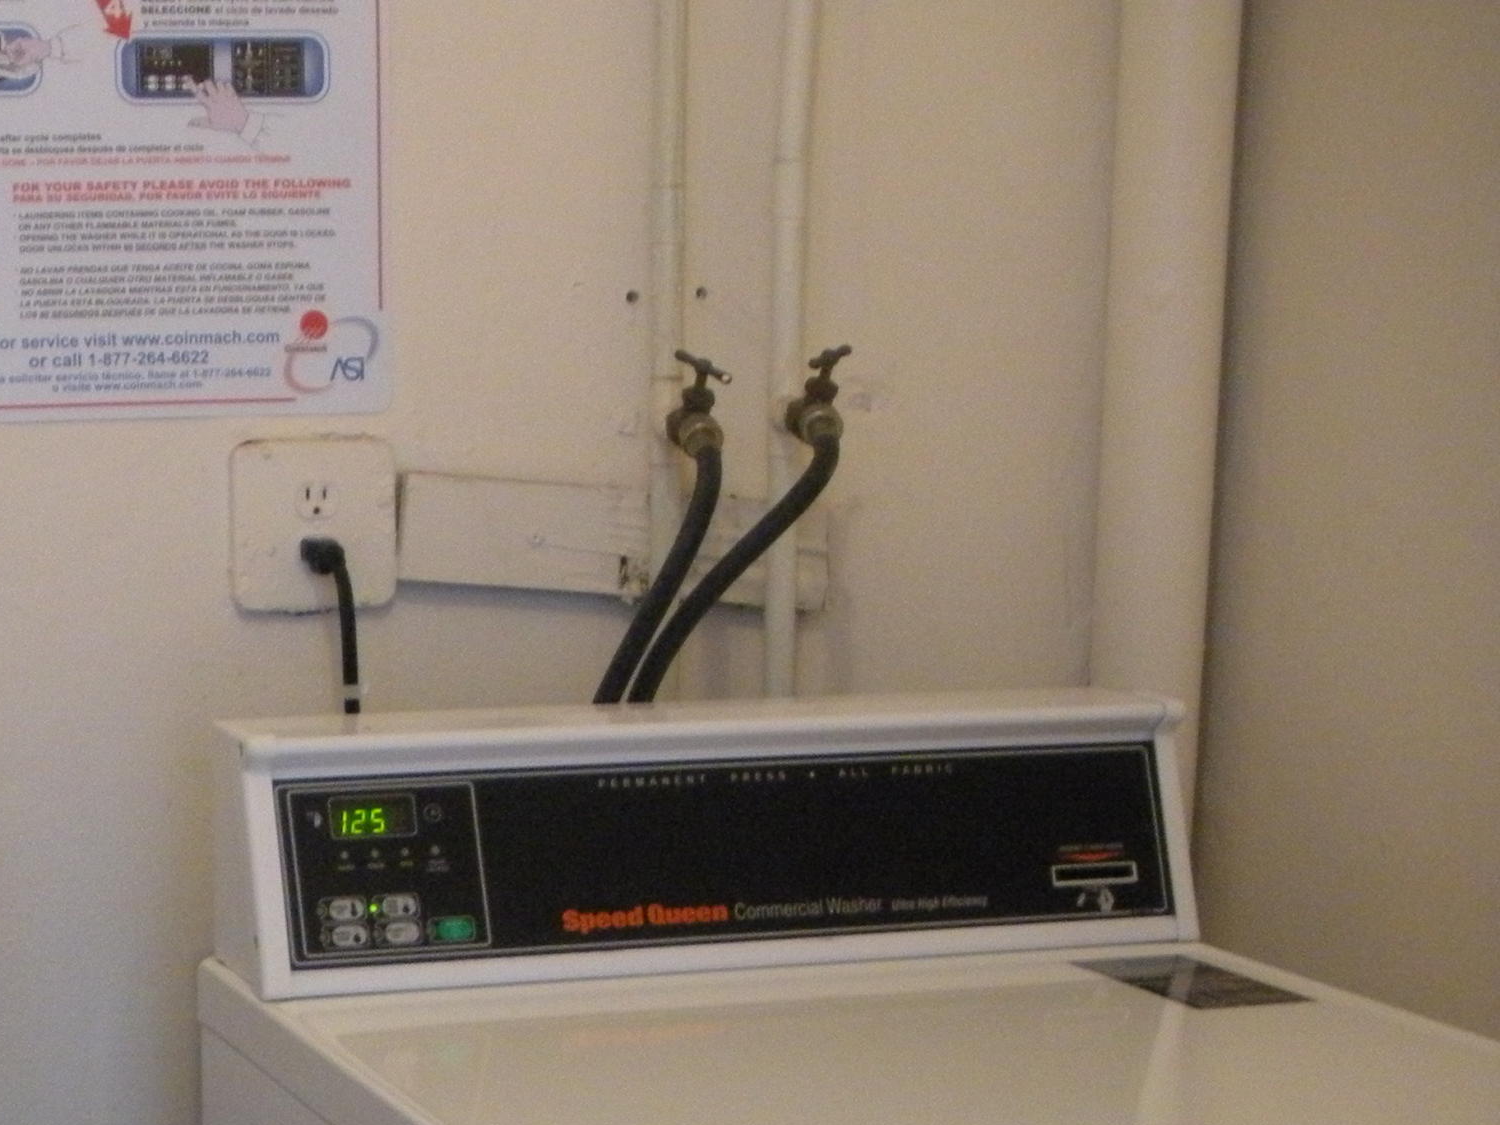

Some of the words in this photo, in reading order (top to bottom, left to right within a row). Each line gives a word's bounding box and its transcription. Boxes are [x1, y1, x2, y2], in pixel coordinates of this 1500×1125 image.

[13, 181, 40, 191] FOR
[44, 181, 80, 190] YOUR
[86, 180, 137, 190] SAFETY
[142, 179, 194, 189] PLEASE
[198, 178, 239, 188] AVOID
[244, 178, 268, 188] THE
[272, 177, 352, 187] FOLLOWING
[21, 333, 78, 348] service
[82, 332, 116, 347] visit
[122, 328, 280, 345] www.coinmach.com
[28, 357, 46, 368] or
[52, 353, 82, 367] call
[88, 350, 210, 366] 1-877-264-6622
[599, 774, 706, 788] PERMANENT
[730, 771, 787, 782] PRESS
[838, 767, 869, 778] ALL
[891, 763, 954, 777] FABRIC
[342, 808, 385, 834] 125
[562, 906, 643, 934] Speed
[647, 903, 729, 926] Queen
[734, 899, 823, 920] Commercial
[826, 897, 882, 916] Washer
